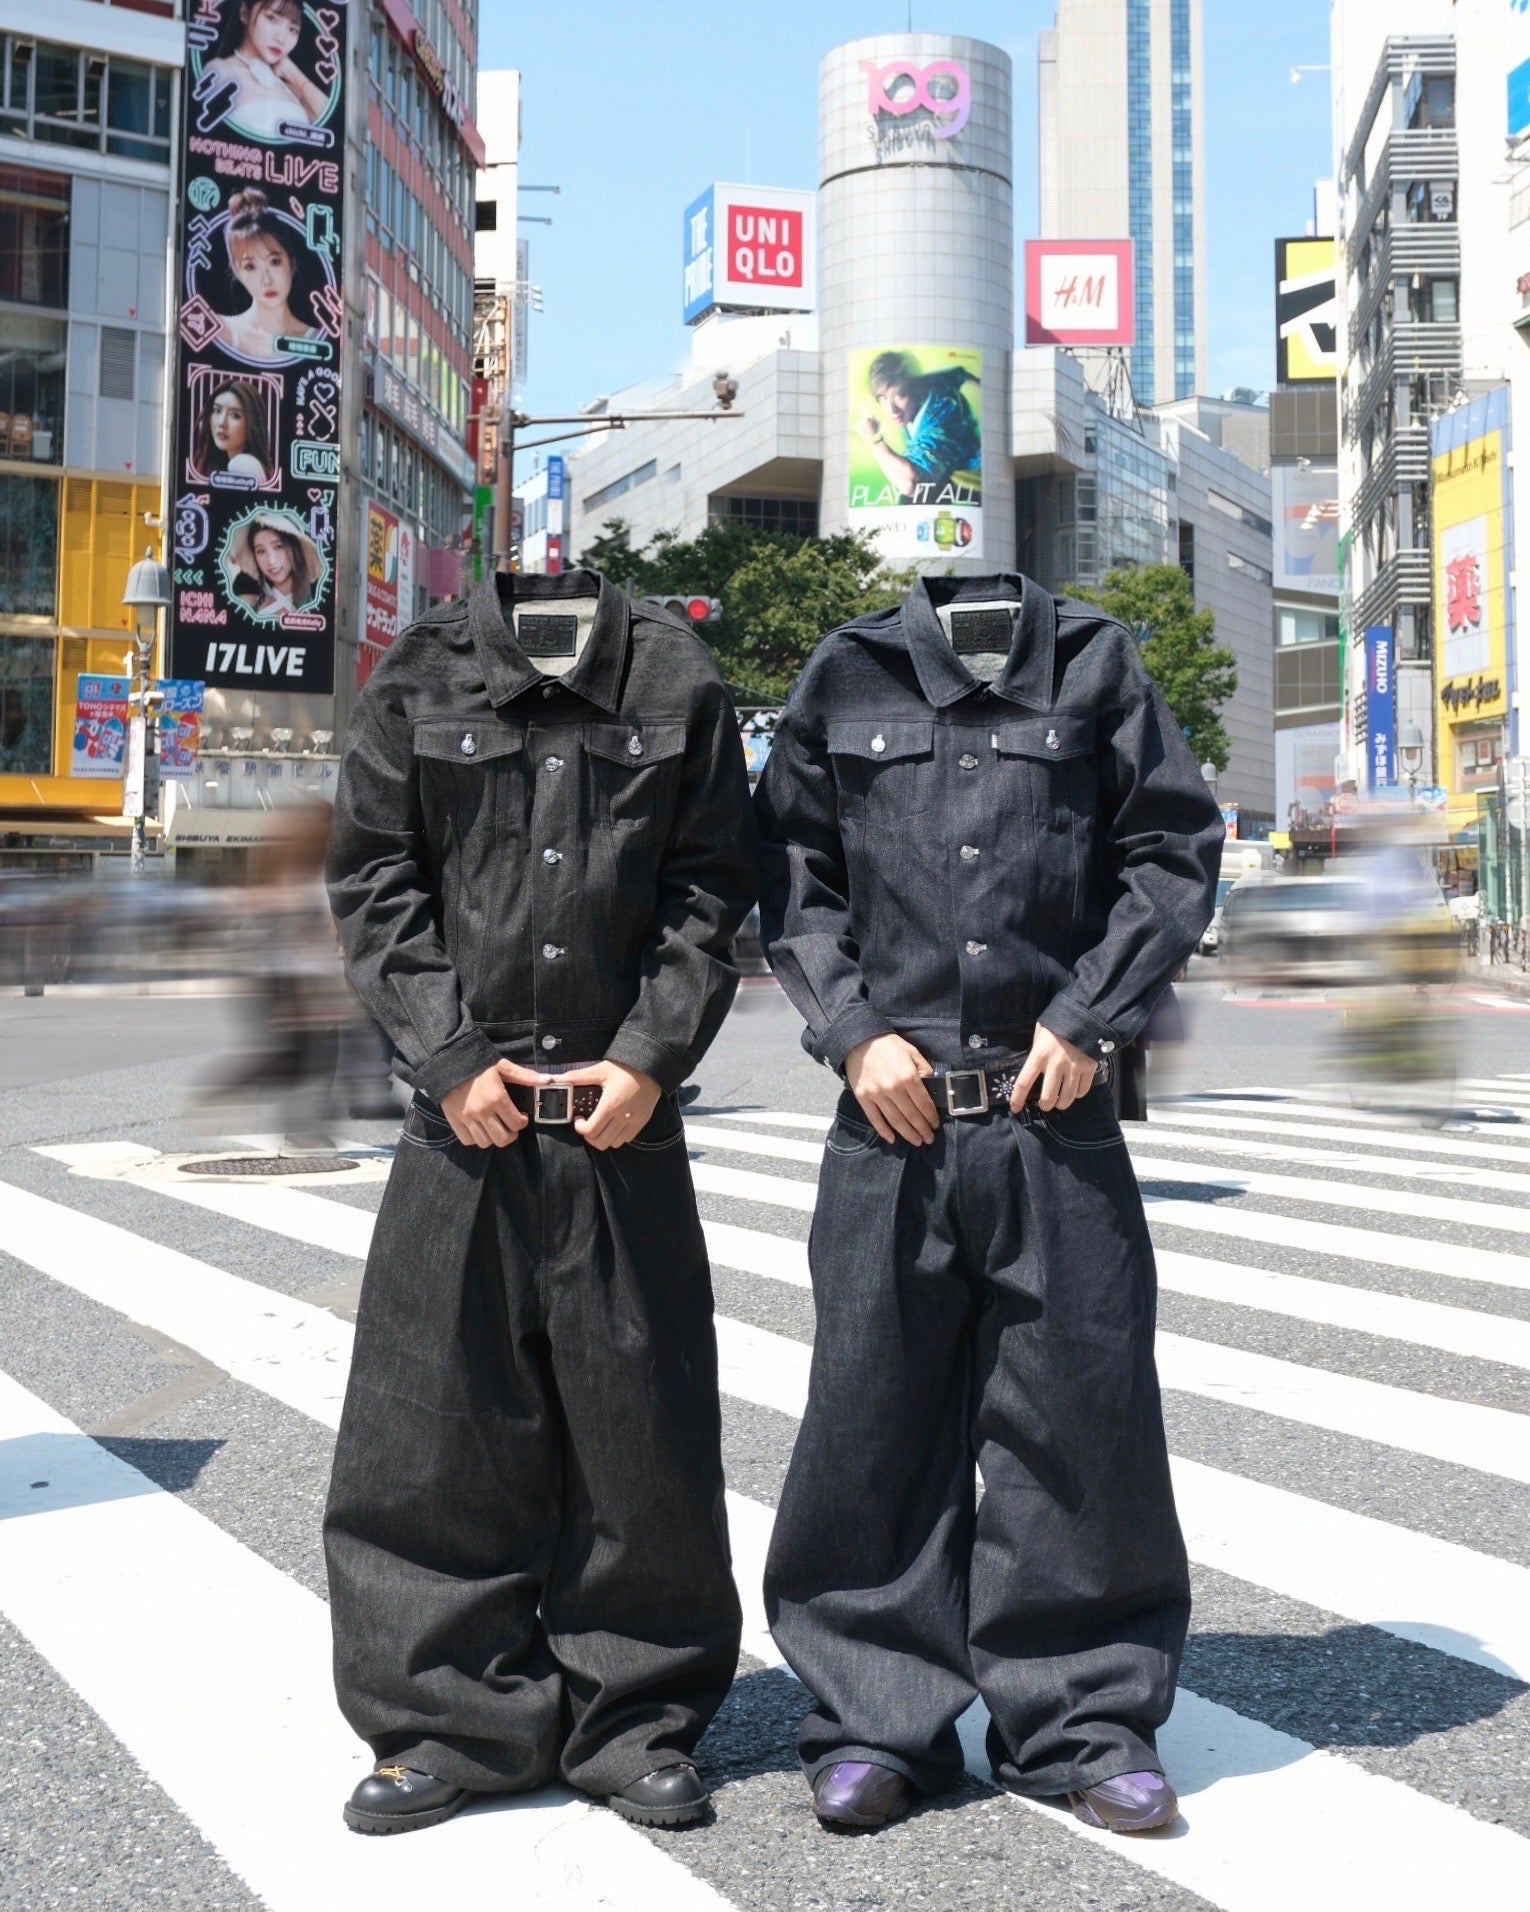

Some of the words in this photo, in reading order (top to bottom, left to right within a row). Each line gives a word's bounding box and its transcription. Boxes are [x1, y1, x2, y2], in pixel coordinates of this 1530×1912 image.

[859, 60, 970, 139] 109
[189, 136, 263, 164] NOTHING
[215, 157, 263, 180] BEATS
[265, 150, 339, 194] LIVE
[735, 214, 790, 246] UNI
[735, 246, 795, 280] QLO
[1053, 275, 1106, 308] H&M
[851, 484, 906, 506] PLAY
[912, 482, 937, 504] IT
[935, 482, 979, 506] ALL
[370, 517, 384, 574] 薬
[180, 590, 215, 608] ICHI
[1446, 553, 1480, 634] 薬
[180, 606, 228, 626] NANA
[205, 642, 307, 677] 17LIVE
[1375, 640, 1389, 695] MIZUHO
[175, 834, 220, 843] SHIBUYA
